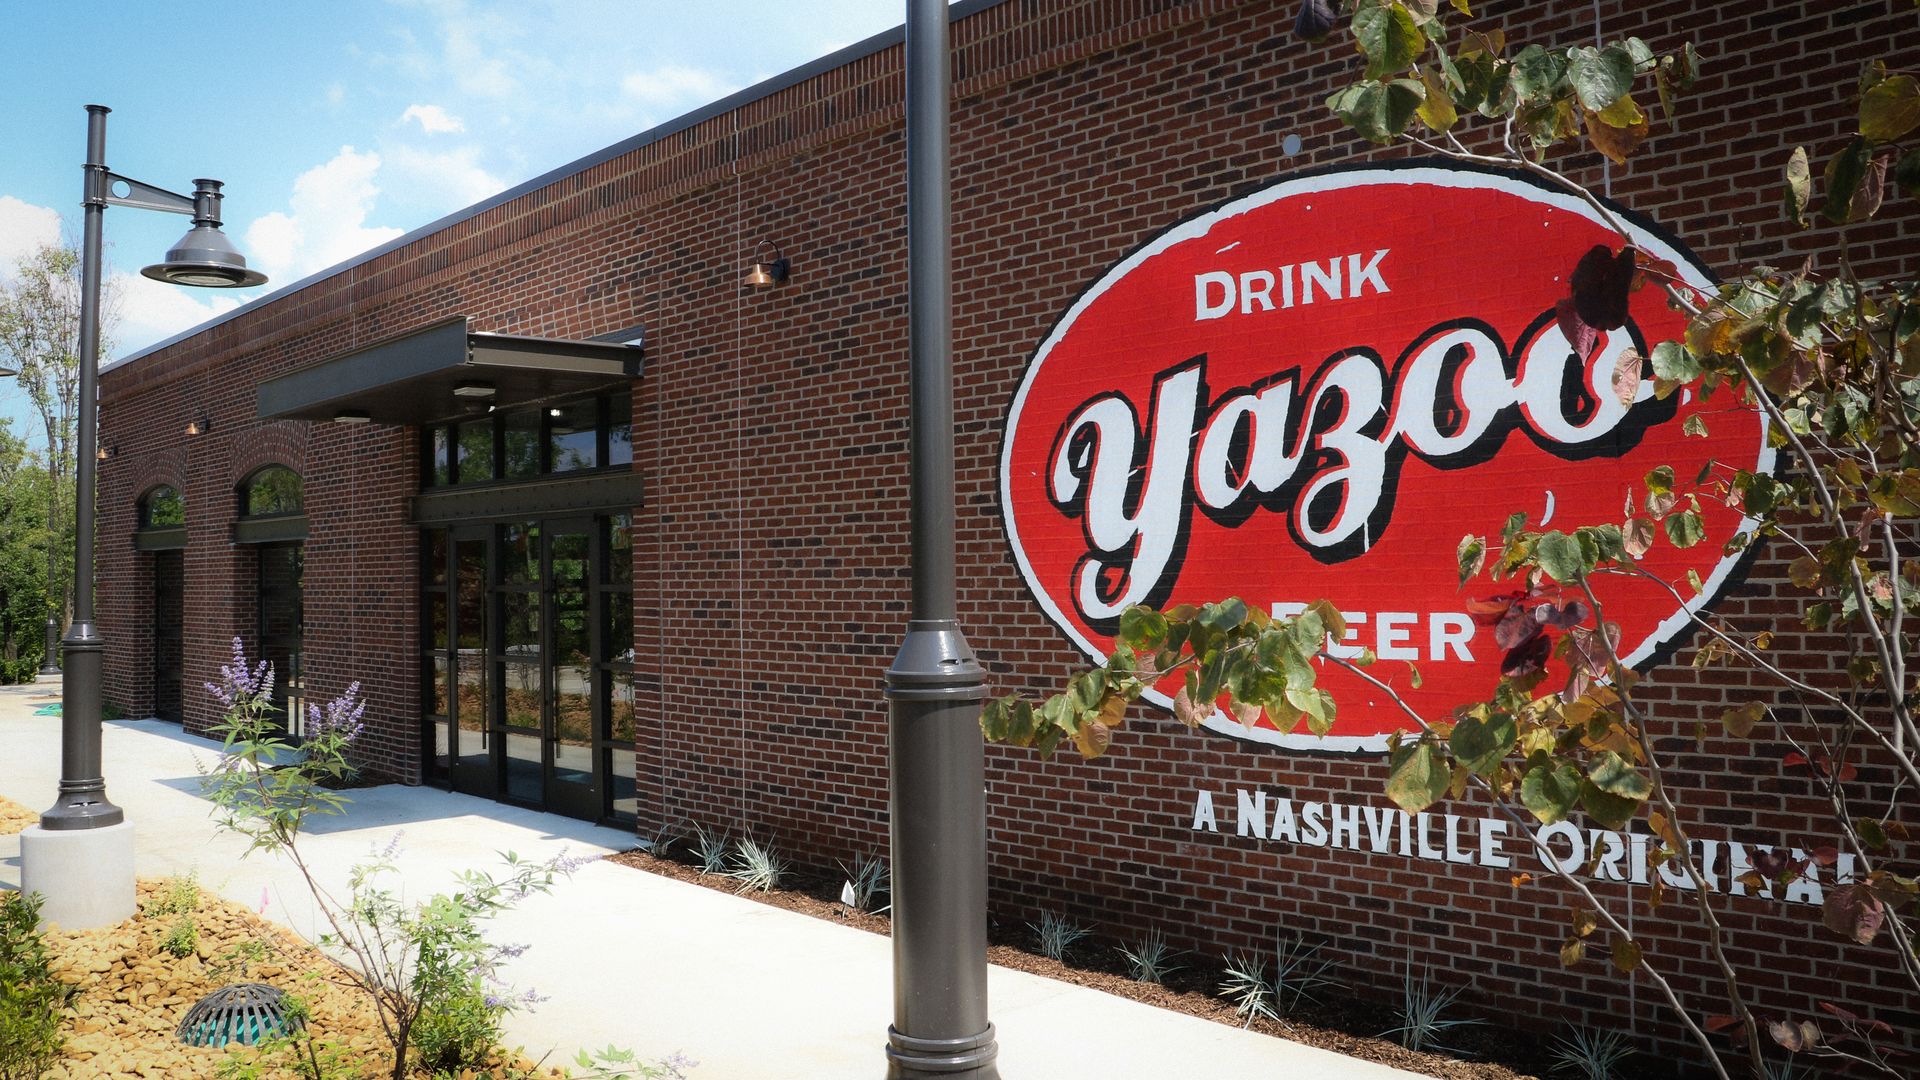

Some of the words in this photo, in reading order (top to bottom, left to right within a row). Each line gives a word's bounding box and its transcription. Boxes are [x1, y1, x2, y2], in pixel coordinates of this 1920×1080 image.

[1194, 249, 1391, 321] DRINK
[1050, 314, 1674, 622] Yazoo
[1271, 602, 1476, 662] EER
[1192, 790, 1218, 832] A
[1237, 788, 1511, 868] NASHVILLE
